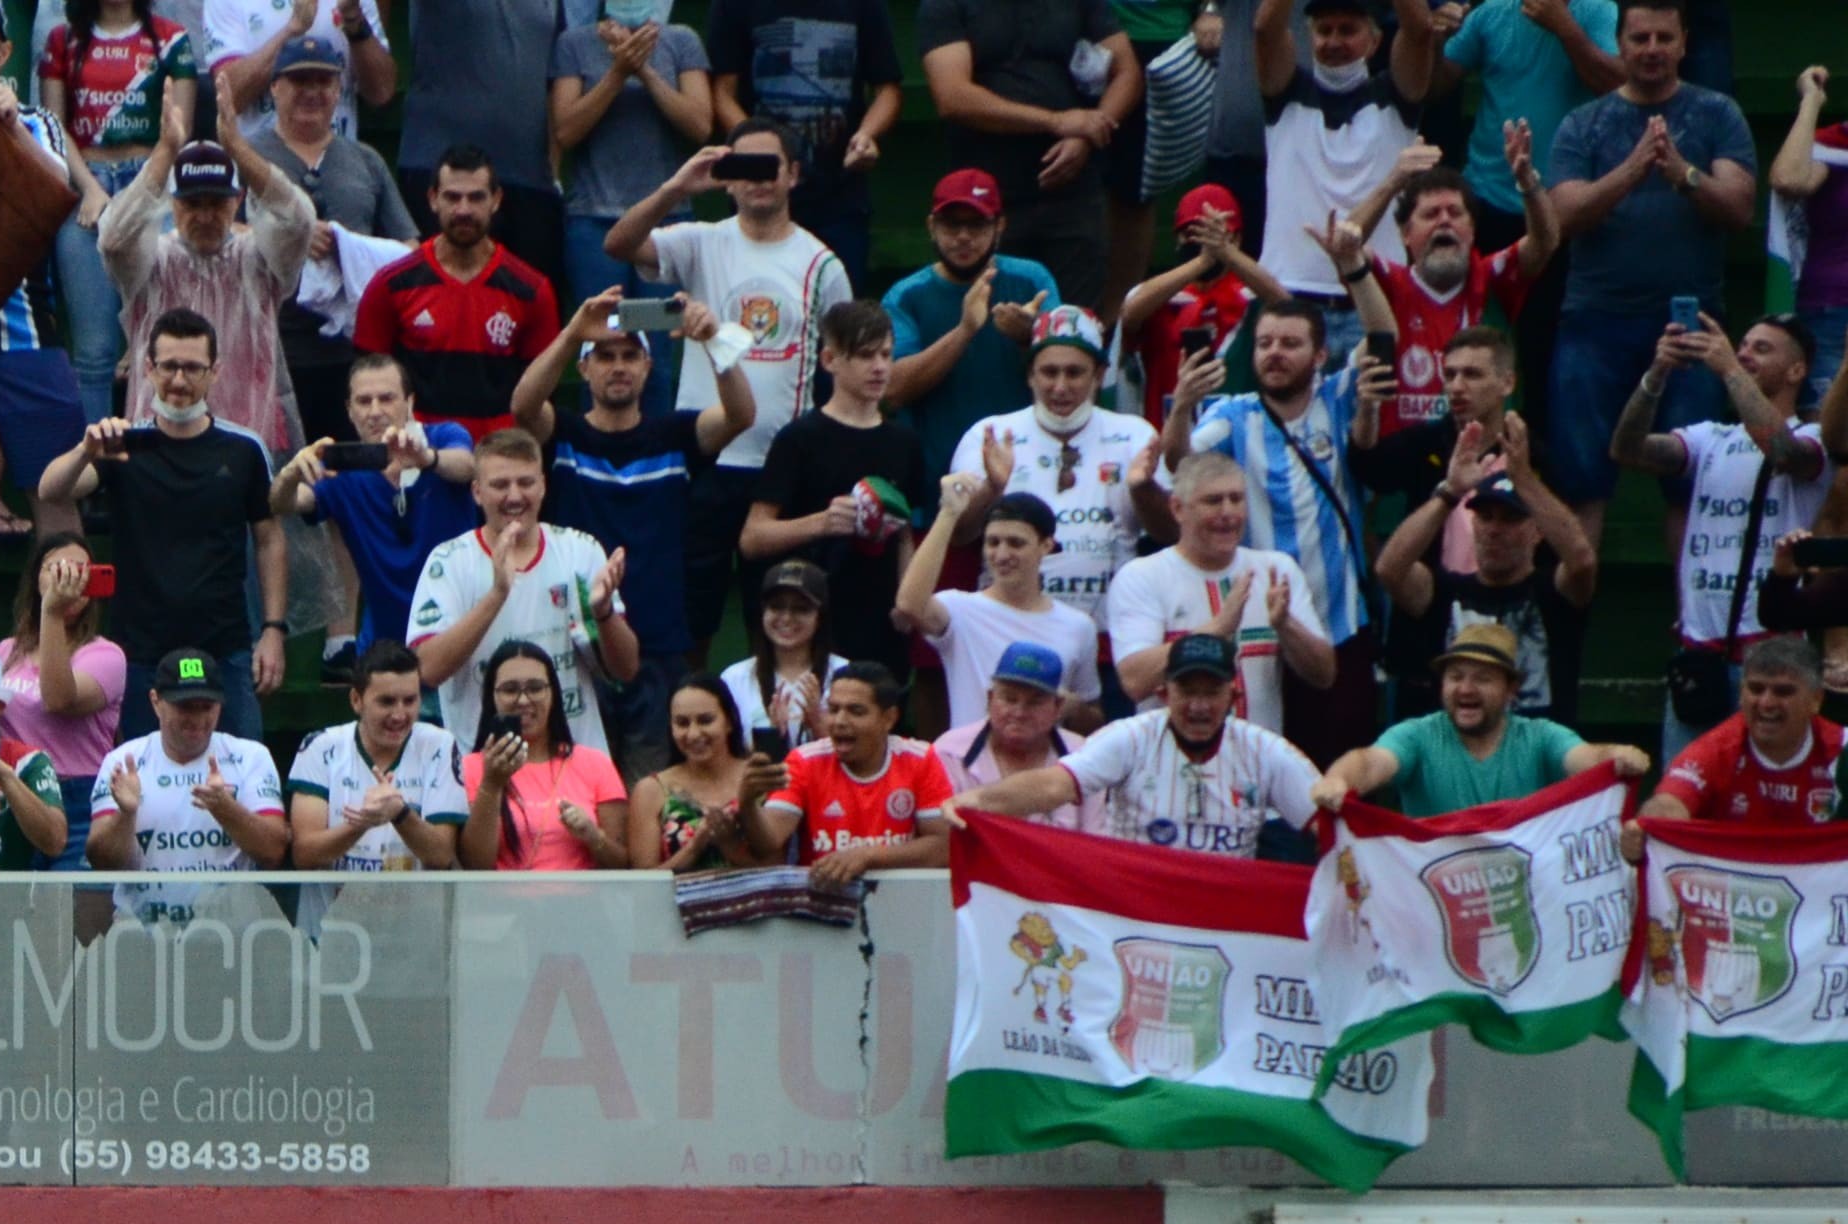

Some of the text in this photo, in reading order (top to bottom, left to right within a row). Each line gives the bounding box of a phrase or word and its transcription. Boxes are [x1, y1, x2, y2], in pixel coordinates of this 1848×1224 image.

[89, 89, 147, 106] SICOOB
[138, 1082, 159, 1124] e
[171, 1075, 377, 1138] Cardiologia
[59, 1139, 133, 1174] (55)
[145, 1142, 371, 1174] 98433-5858
